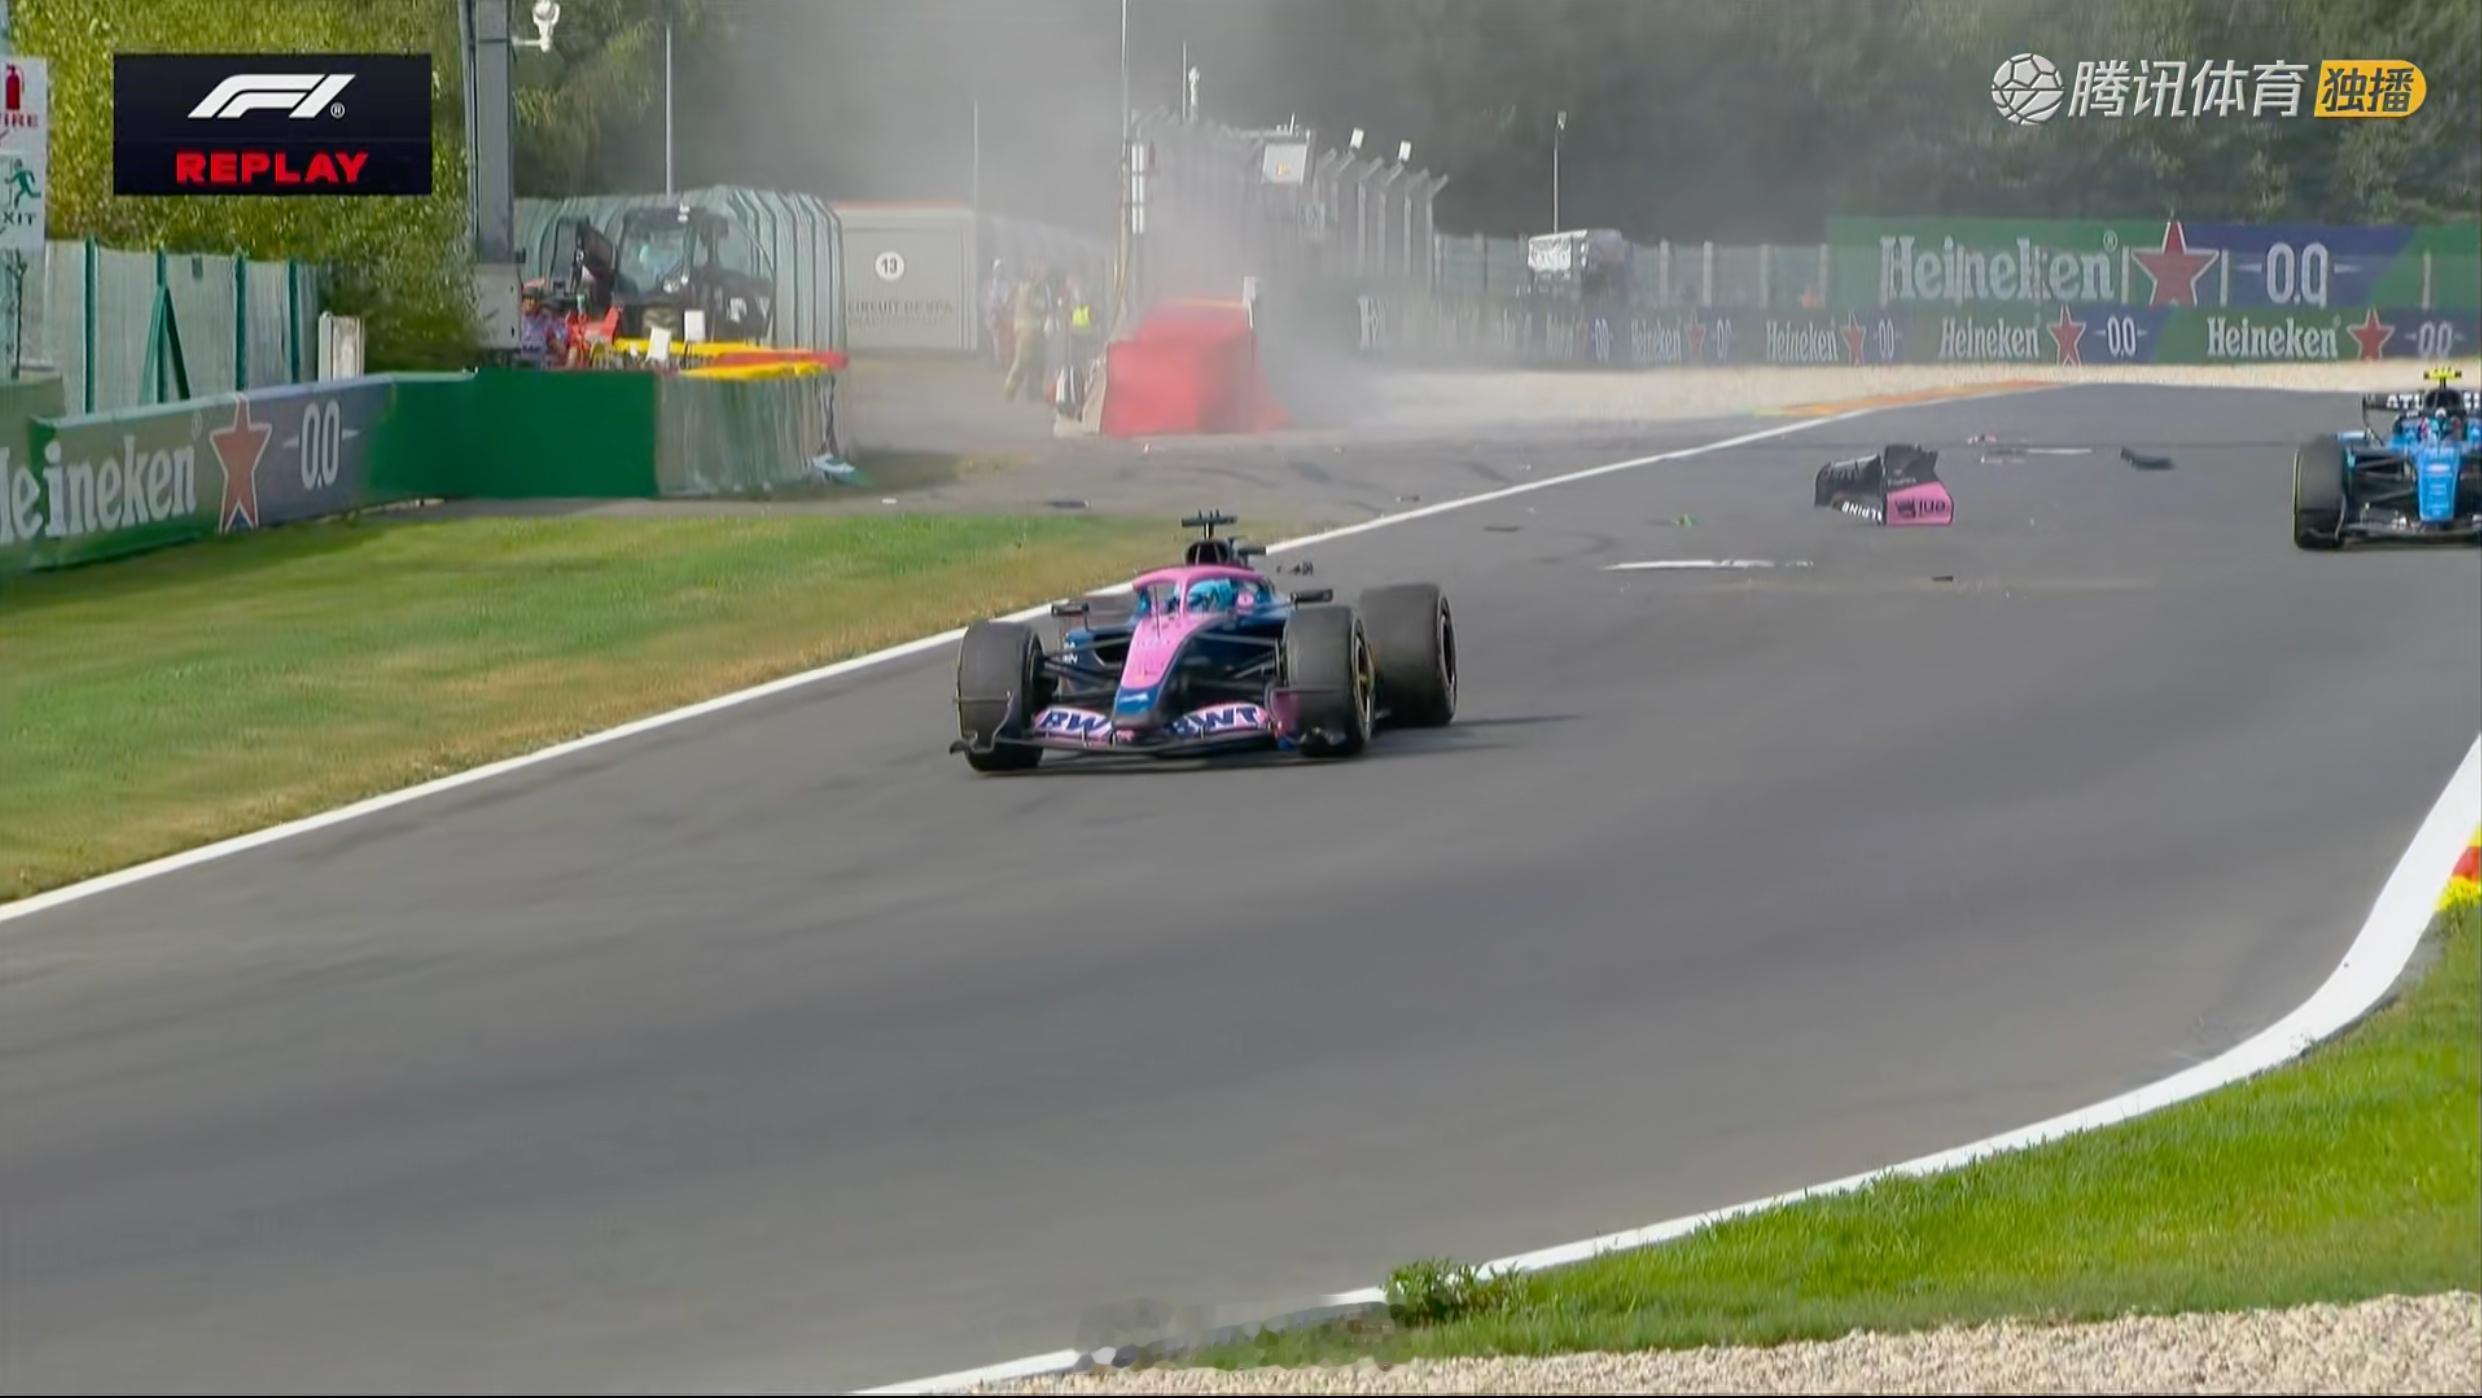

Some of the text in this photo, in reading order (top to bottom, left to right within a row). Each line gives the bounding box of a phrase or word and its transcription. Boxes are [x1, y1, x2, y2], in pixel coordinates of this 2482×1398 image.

[0, 112, 38, 128] IRE
[0, 211, 36, 226] XIT
[1879, 235, 2114, 301] Heineken
[1766, 319, 1839, 361] Heineken
[1938, 316, 2040, 358] Heineken
[2207, 316, 2339, 359] Heineken
[302, 399, 340, 491] 0.0
[1040, 708, 1112, 733] BW
